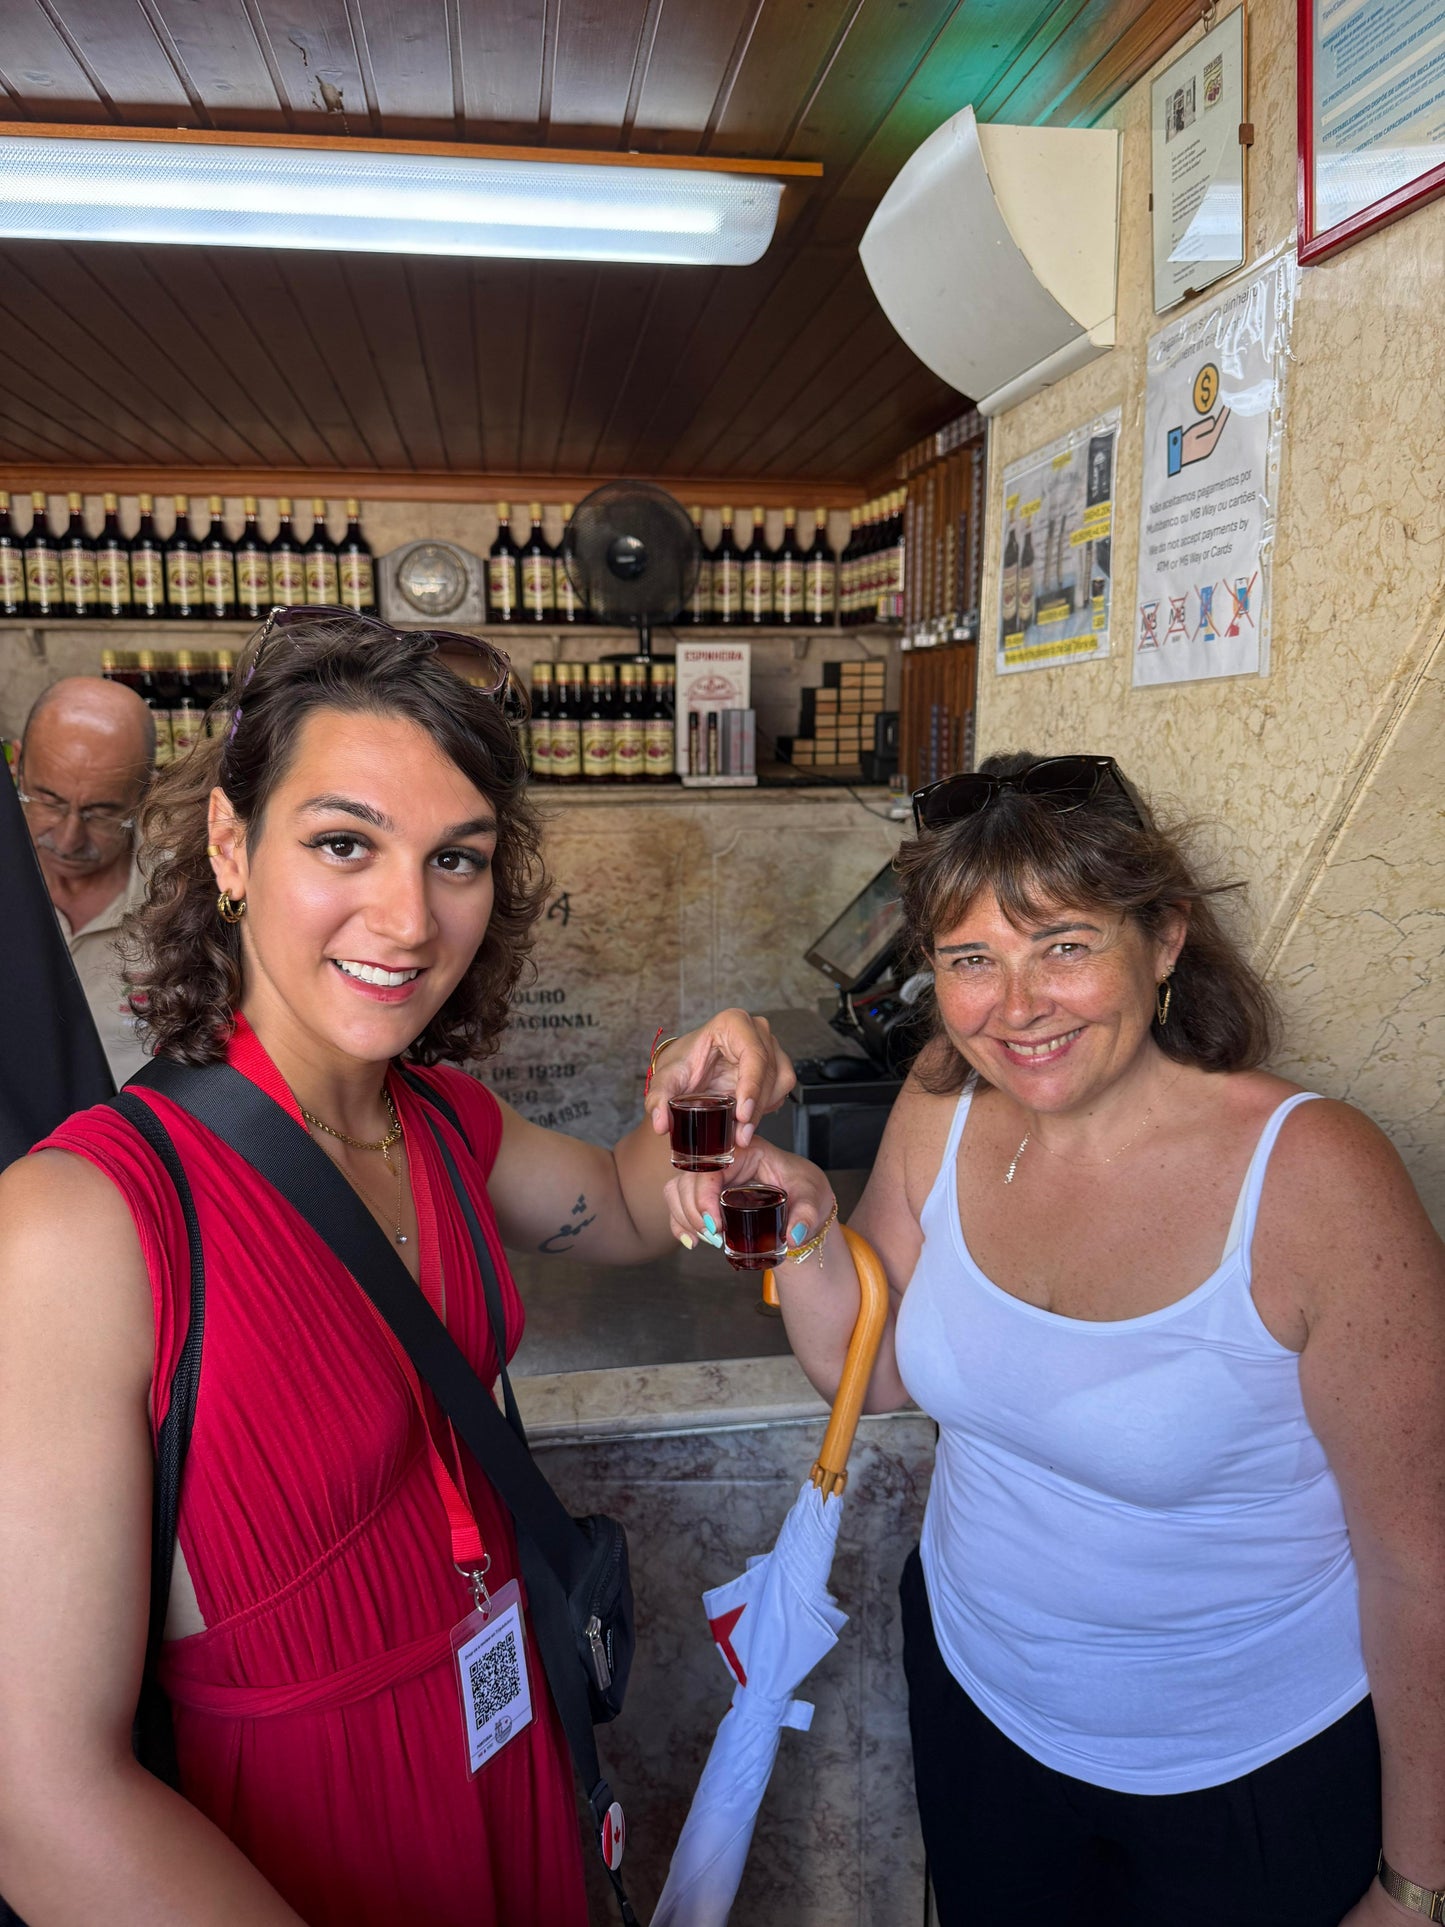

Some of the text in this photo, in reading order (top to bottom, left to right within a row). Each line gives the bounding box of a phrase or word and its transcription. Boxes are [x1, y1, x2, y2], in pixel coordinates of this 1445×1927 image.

[1390, 39, 1406, 56] PODEM
[1407, 31, 1416, 44] SER
[1322, 130, 1331, 143] ESTE
[1388, 86, 1393, 96] DE
[1409, 71, 1415, 81] DE
[1373, 130, 1382, 141] TEM
[1383, 110, 1411, 135] CAPACIDADE
[1413, 96, 1433, 115] MÁXIMA
[1197, 475, 1239, 501] pagamentos
[1240, 469, 1252, 485] por
[1180, 514, 1188, 523] ou
[1190, 508, 1201, 520] MB
[1202, 503, 1217, 517] Way
[1217, 500, 1228, 512] ou
[1228, 491, 1256, 509] cartões
[1168, 539, 1179, 550] not
[1180, 530, 1201, 546] accept
[1201, 521, 1238, 542] payments
[1239, 517, 1249, 534] by
[1157, 542, 1233, 570] ATM or MB Way or Cards
[685, 650, 744, 662] ESPINHEIRA
[508, 1011, 601, 1030] ACIONAL
[557, 1099, 593, 1126] 1932
